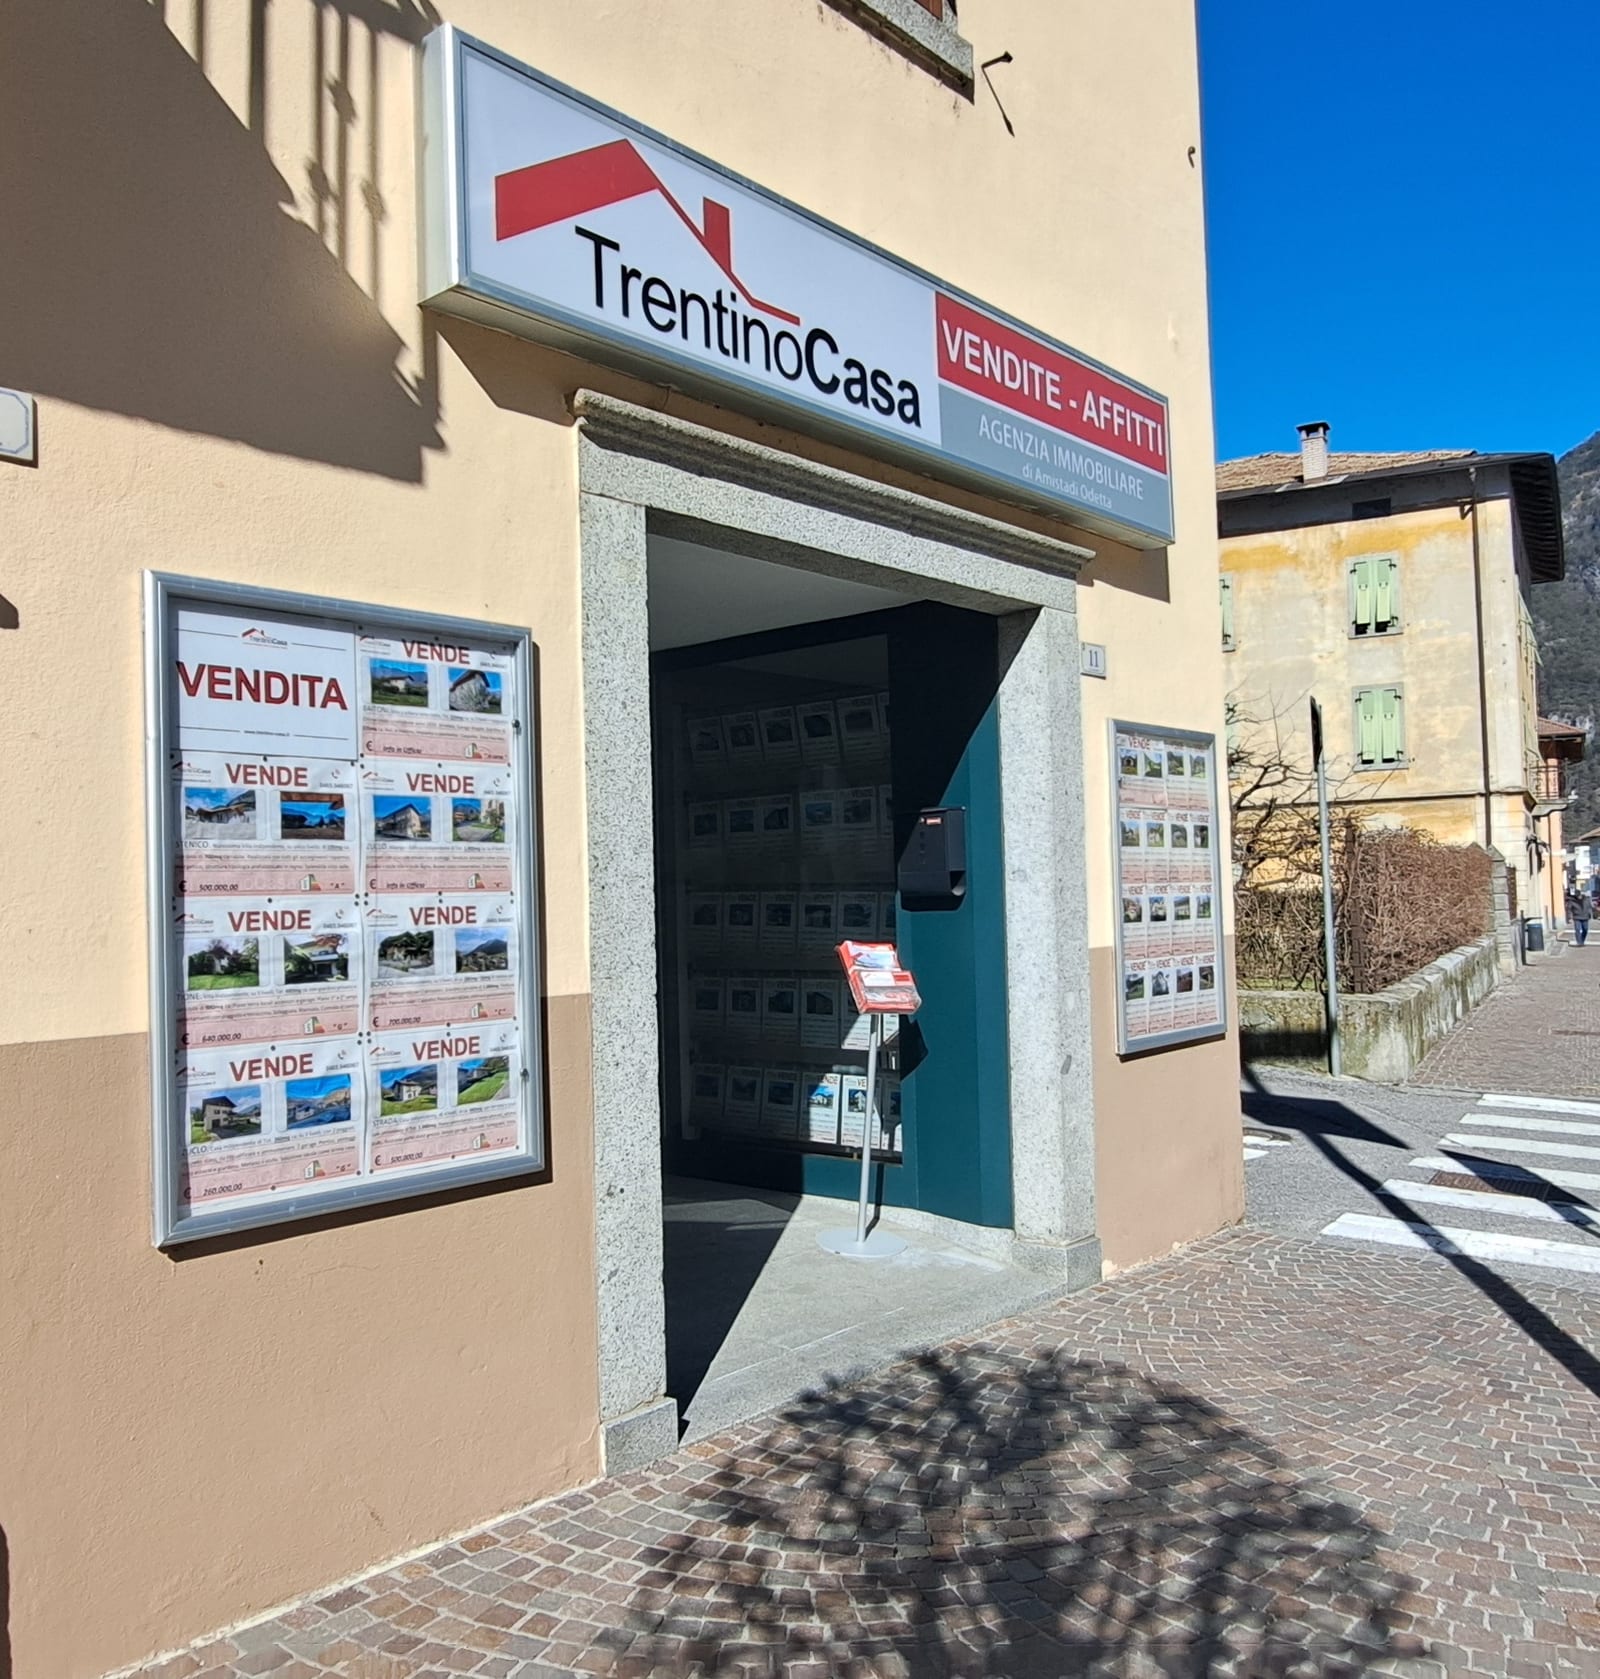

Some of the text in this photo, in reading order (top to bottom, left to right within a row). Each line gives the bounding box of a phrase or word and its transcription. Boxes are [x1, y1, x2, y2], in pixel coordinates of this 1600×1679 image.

[575, 226, 921, 429] TrentinoCasa
[942, 320, 1062, 411] VENDITE
[1082, 389, 1163, 456] AFFITTI
[979, 414, 1144, 501] AGENZIA IMMOBILIARE
[1022, 463, 1113, 509] di Amistadi Odetta
[401, 639, 470, 665] VENDE
[1089, 650, 1099, 668] 11
[175, 660, 348, 711] VENDITA
[366, 740, 373, 751] €
[1128, 736, 1152, 750] VENDE
[225, 763, 309, 787] VENDE
[406, 772, 475, 795] VENDE
[179, 880, 187, 892] €
[369, 879, 377, 890] €
[228, 909, 311, 932] VENDE
[409, 906, 477, 926] VENDE
[372, 1017, 379, 1027] €
[182, 1032, 242, 1045] € 640.000,00
[412, 1036, 480, 1061] VENDE
[230, 1053, 314, 1082] VENDE
[374, 1155, 381, 1166] €
[202, 1183, 243, 1197] 260.000,00
